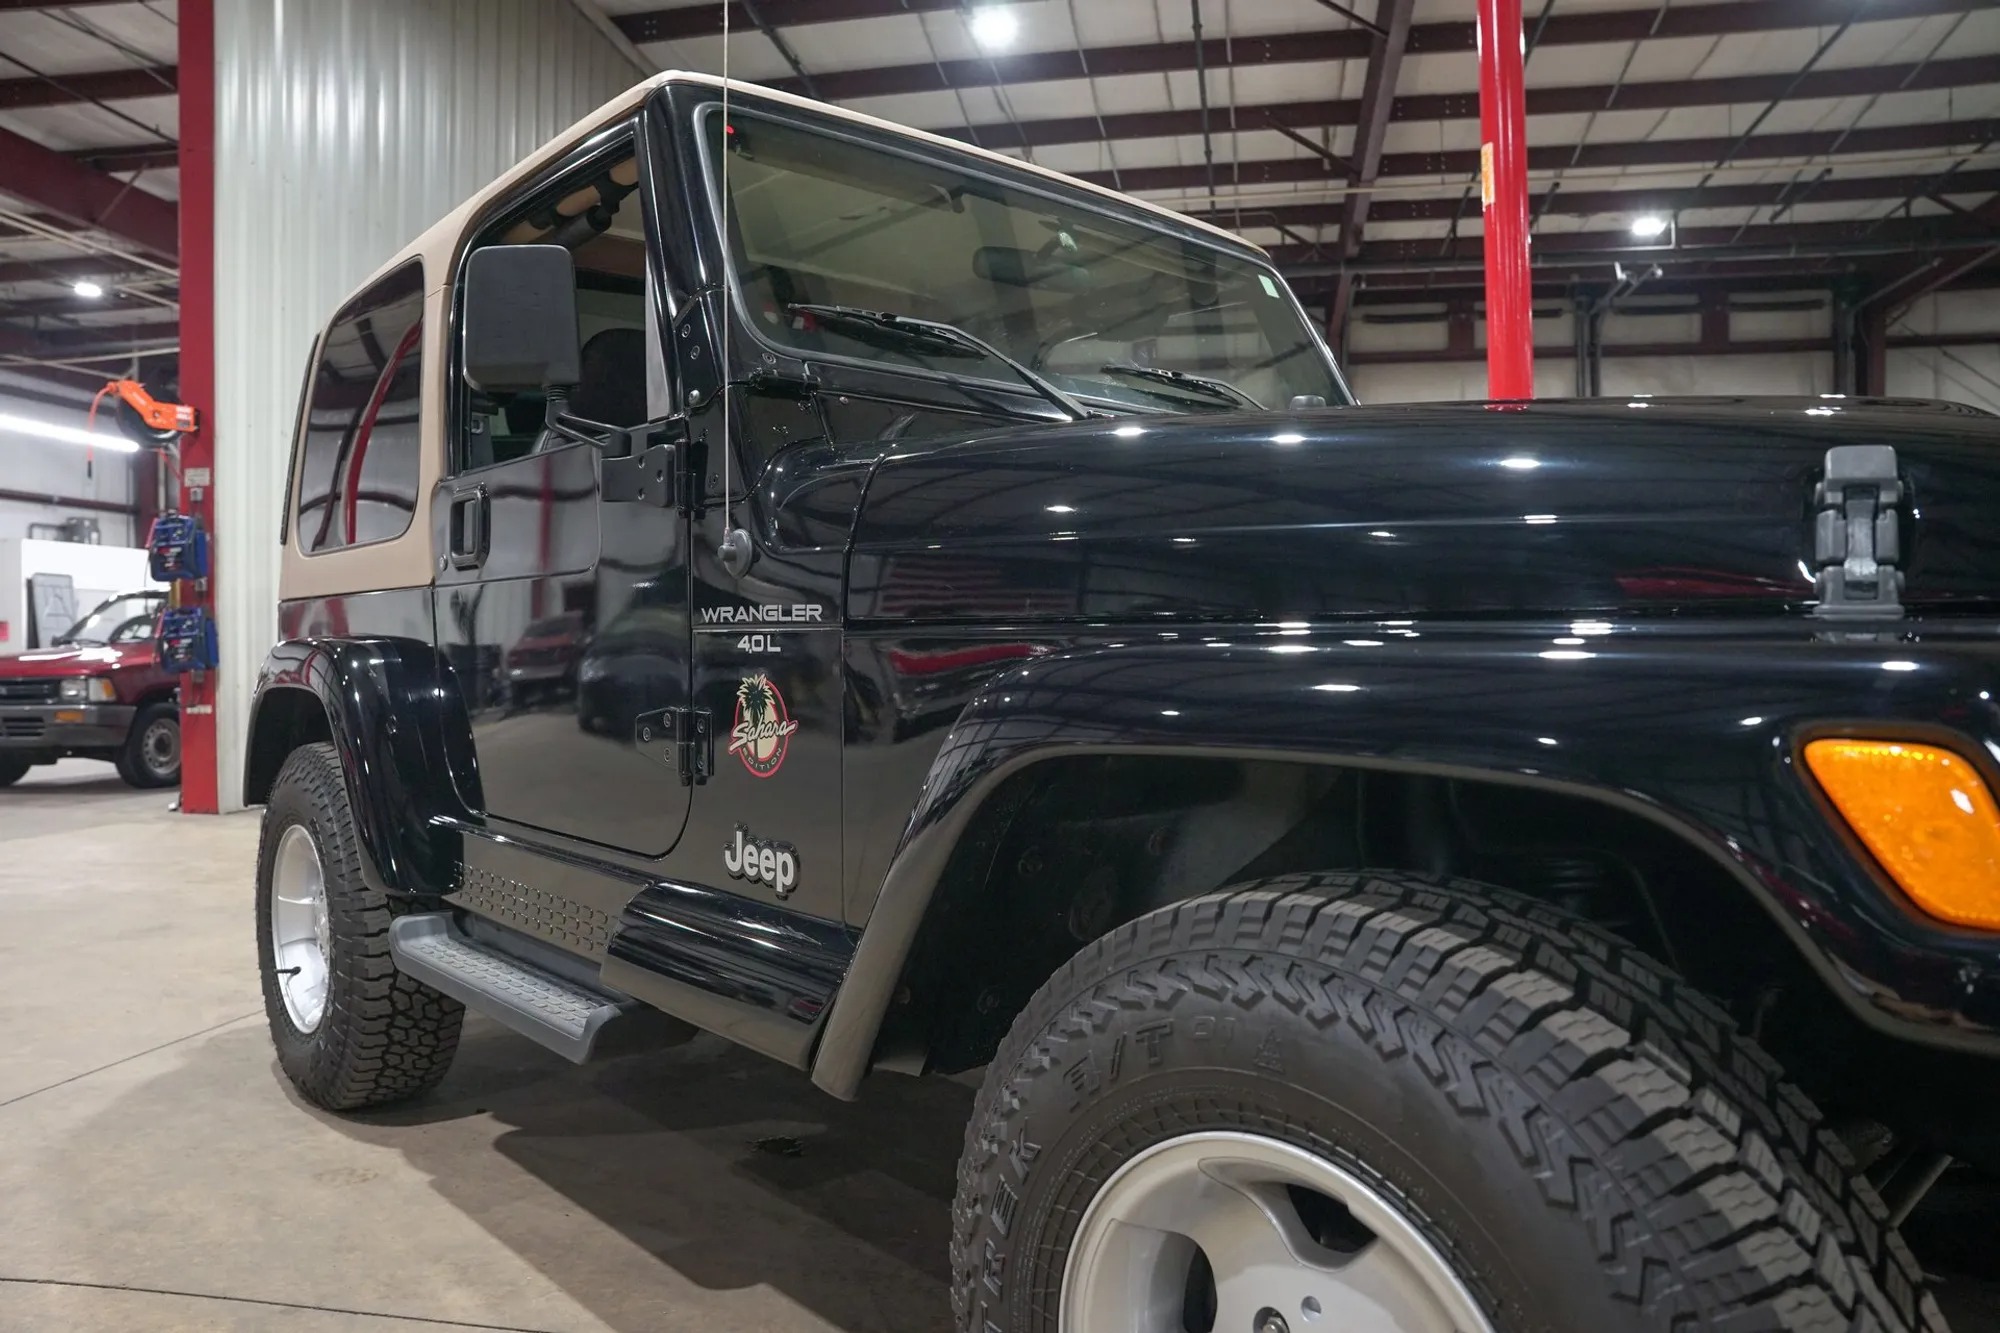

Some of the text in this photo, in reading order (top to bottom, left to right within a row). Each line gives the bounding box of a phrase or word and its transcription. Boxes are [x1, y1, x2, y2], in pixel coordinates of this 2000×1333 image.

[700, 604, 823, 623] WRANGLER
[729, 715, 797, 752] Sahara
[724, 830, 795, 893] Jeep
